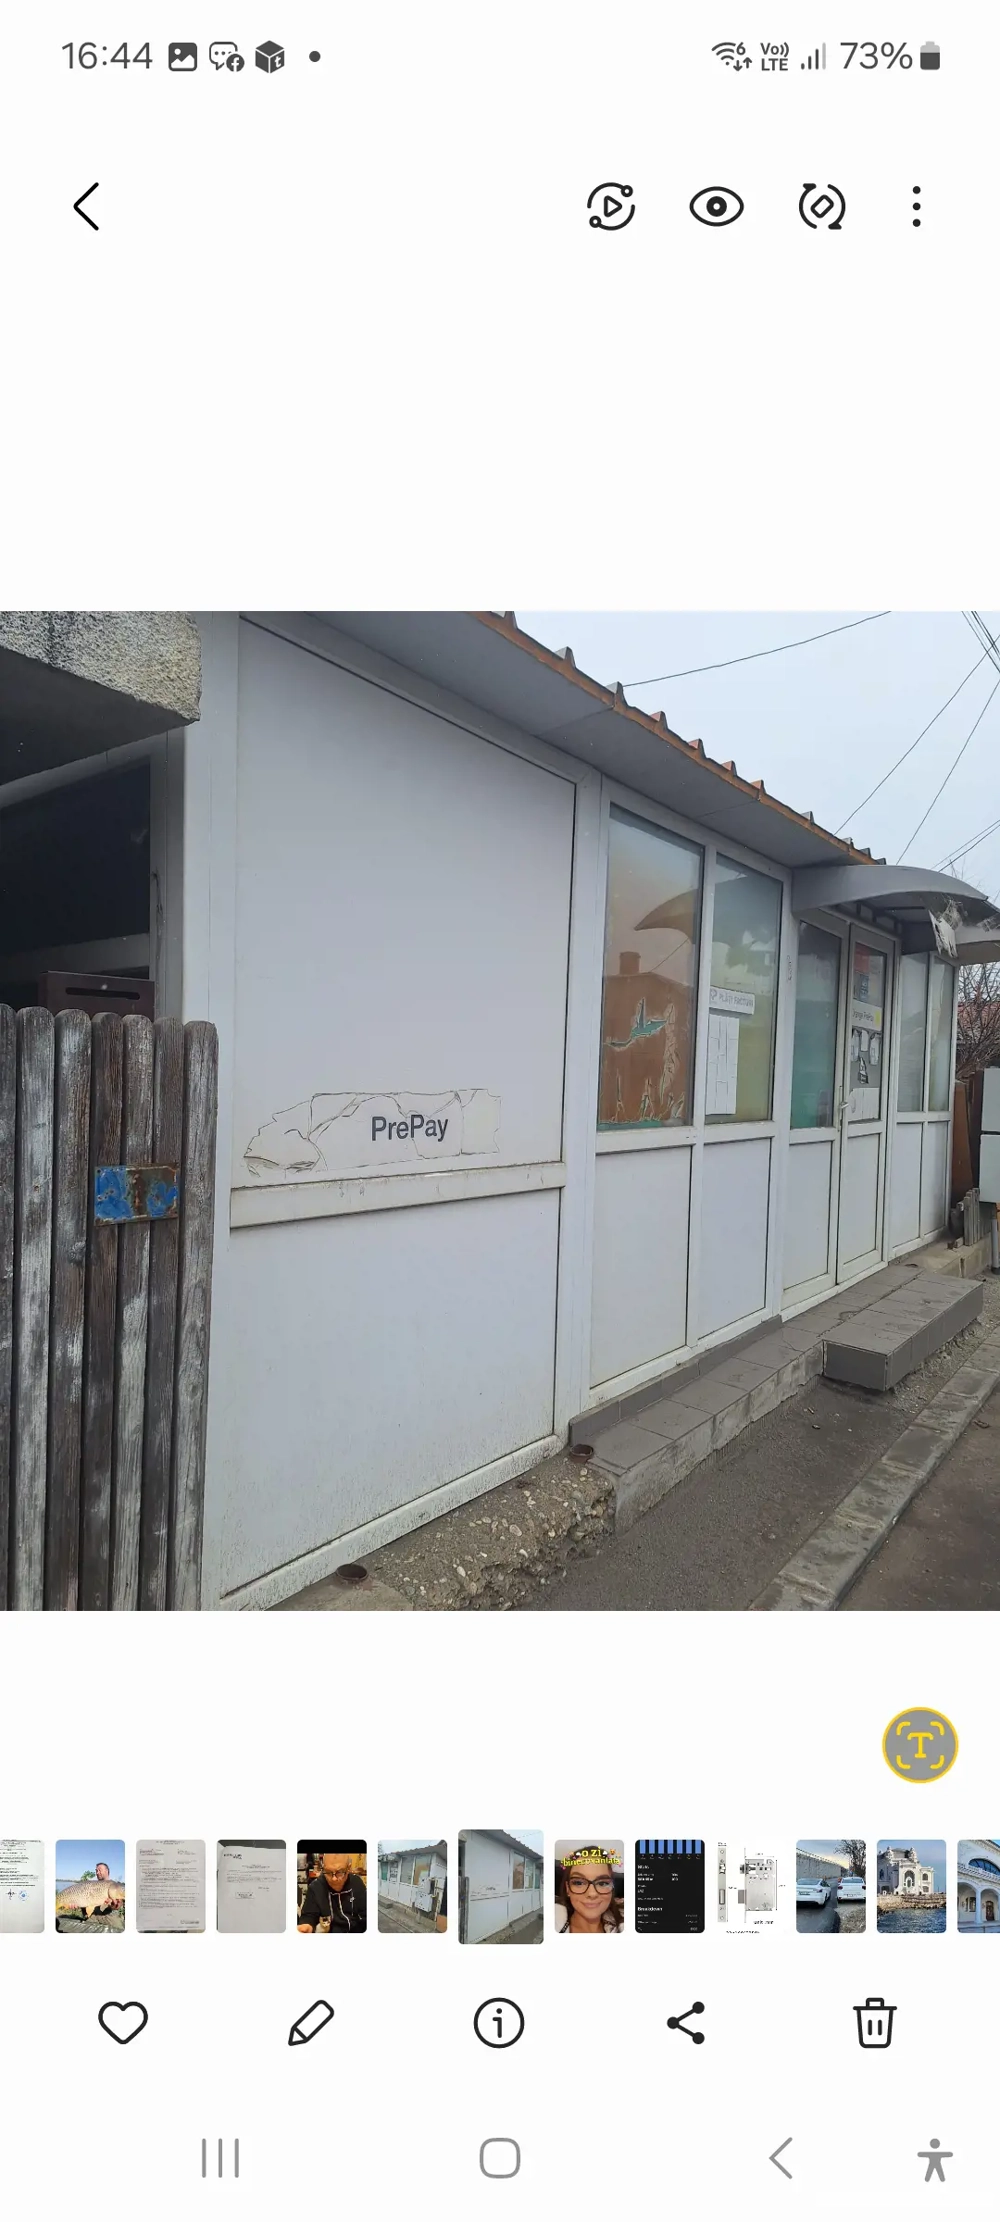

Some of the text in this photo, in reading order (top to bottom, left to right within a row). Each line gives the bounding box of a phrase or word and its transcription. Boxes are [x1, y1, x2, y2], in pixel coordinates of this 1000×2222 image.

[62, 42, 153, 70] 16:44
[761, 58, 788, 71] LTE
[840, 42, 913, 69] 73%
[372, 1114, 449, 1142] PrePay
[591, 1846, 602, 1857] zi
